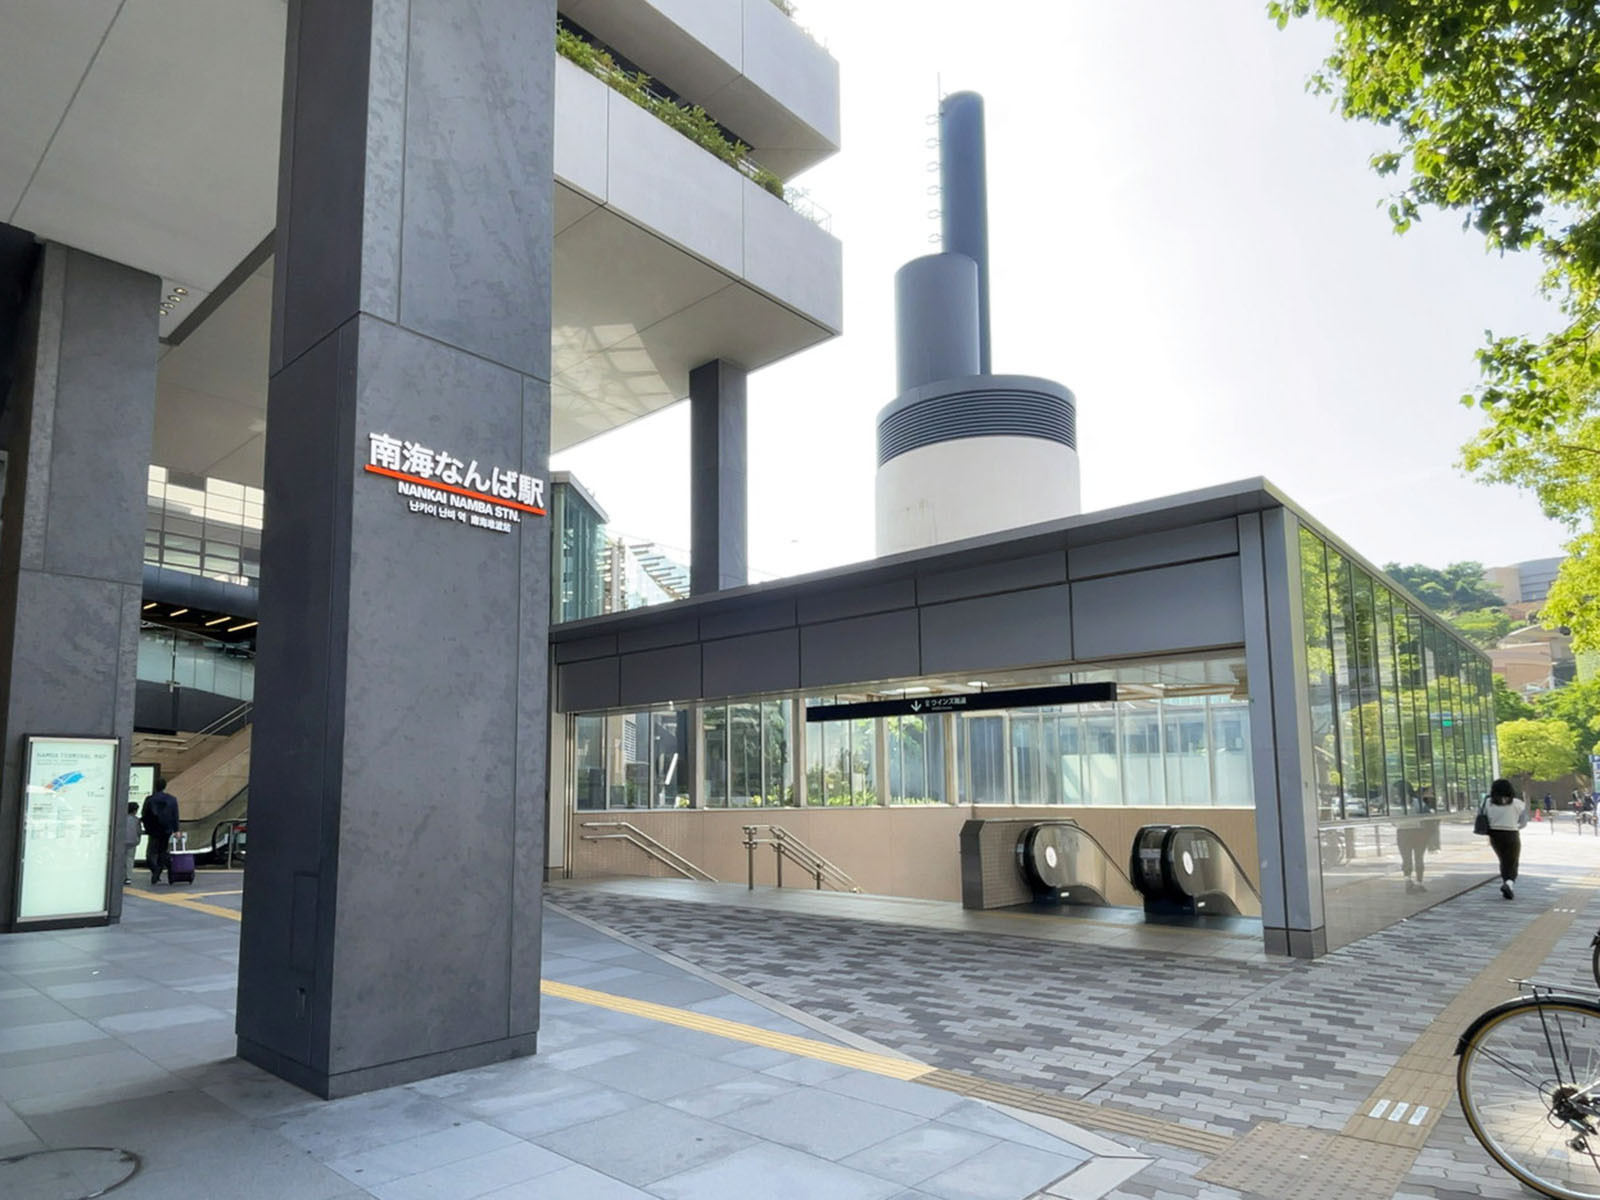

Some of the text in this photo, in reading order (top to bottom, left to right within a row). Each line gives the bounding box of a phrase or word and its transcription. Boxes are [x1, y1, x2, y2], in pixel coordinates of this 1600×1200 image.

[369, 432, 544, 508] 南海なんば駅
[398, 481, 521, 522] NANKAI NAMBA STN.
